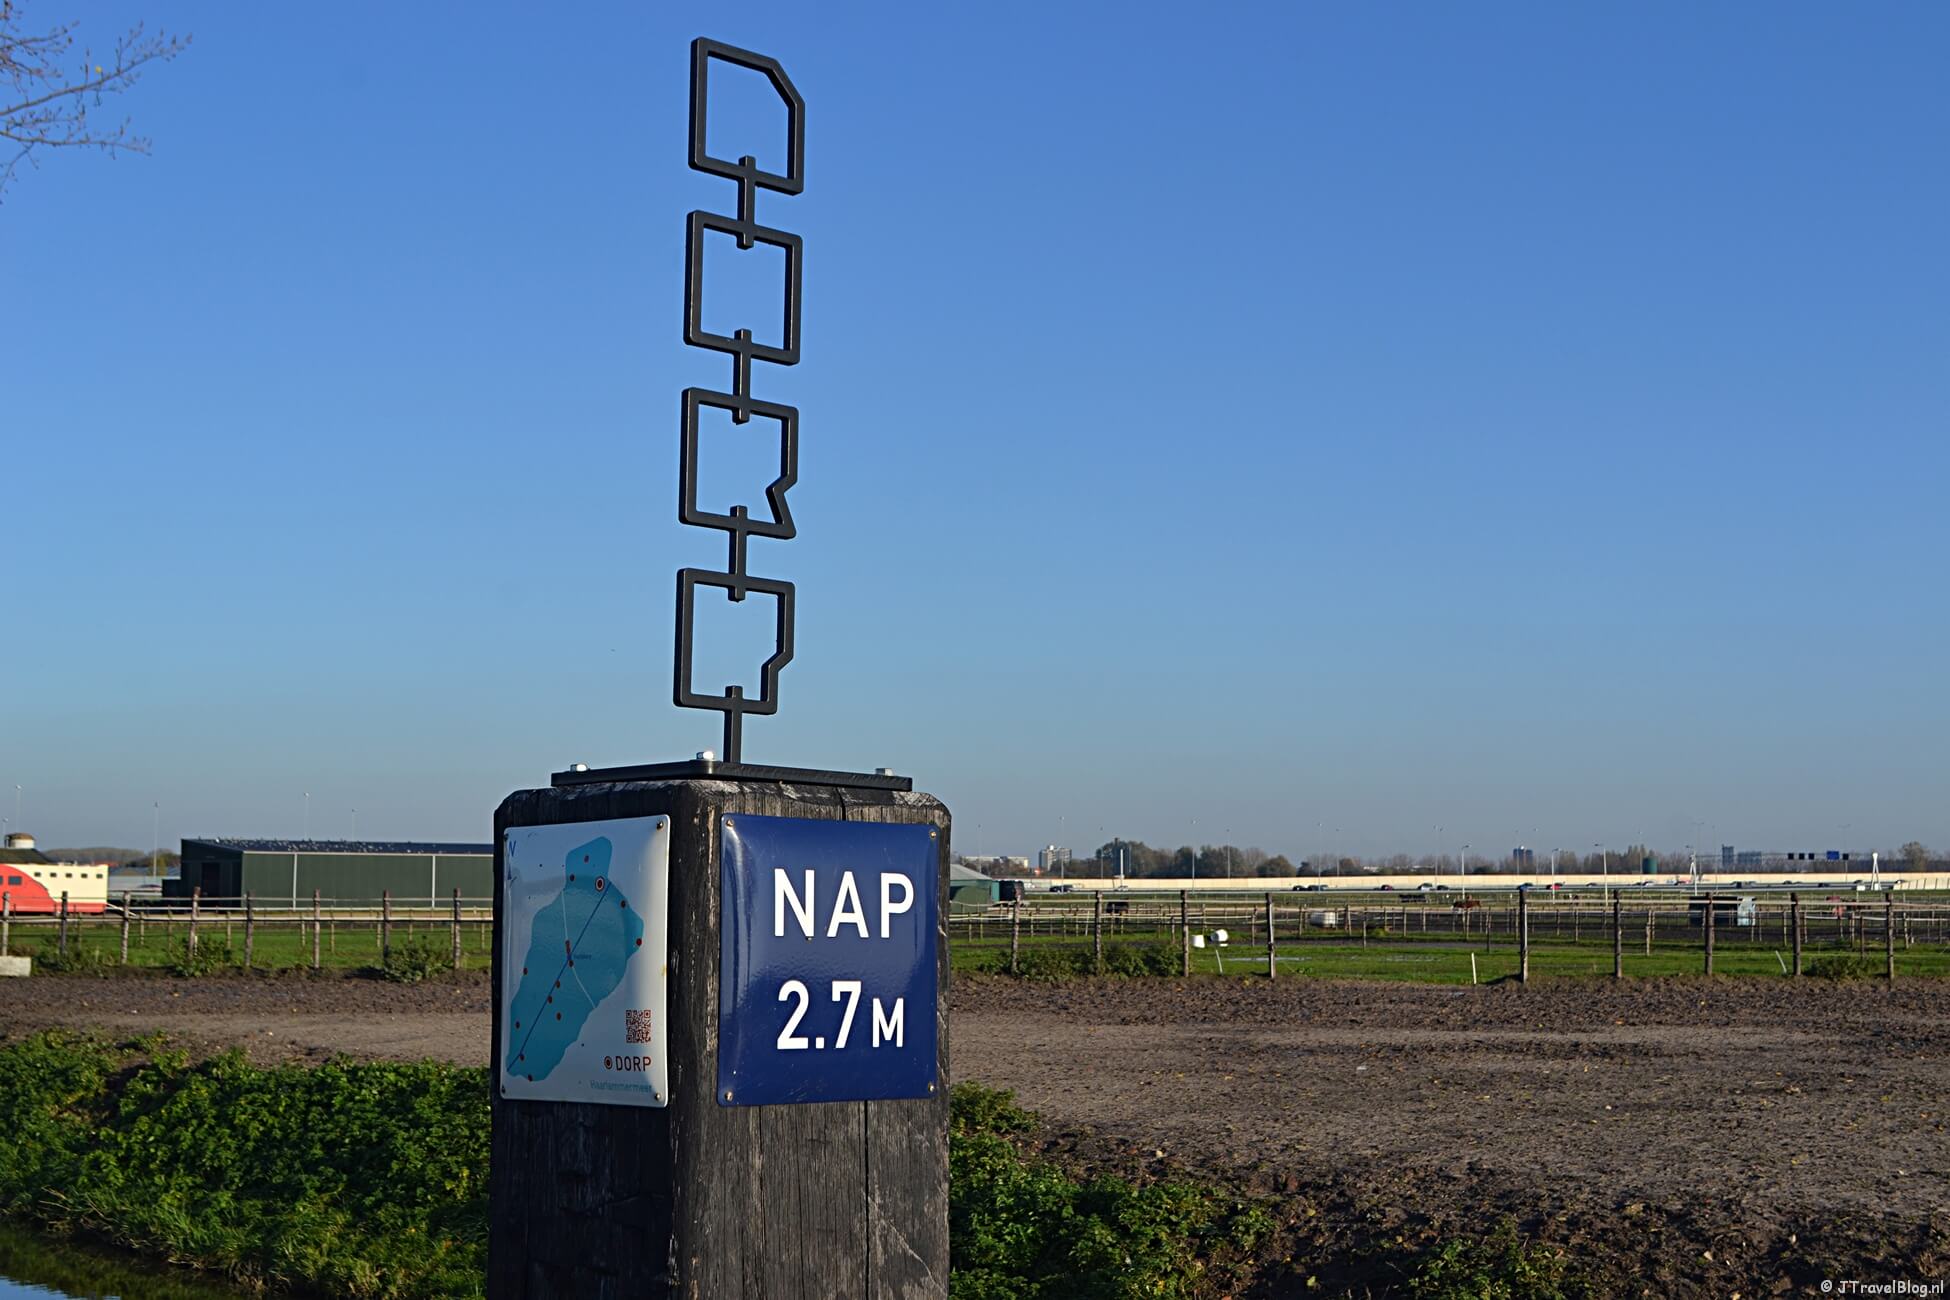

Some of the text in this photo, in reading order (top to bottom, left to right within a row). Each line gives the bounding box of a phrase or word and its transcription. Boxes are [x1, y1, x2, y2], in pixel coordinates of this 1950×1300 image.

[774, 868, 914, 939] NAP
[777, 980, 904, 1050] 2.7 M
[615, 1055, 652, 1072] DORP
